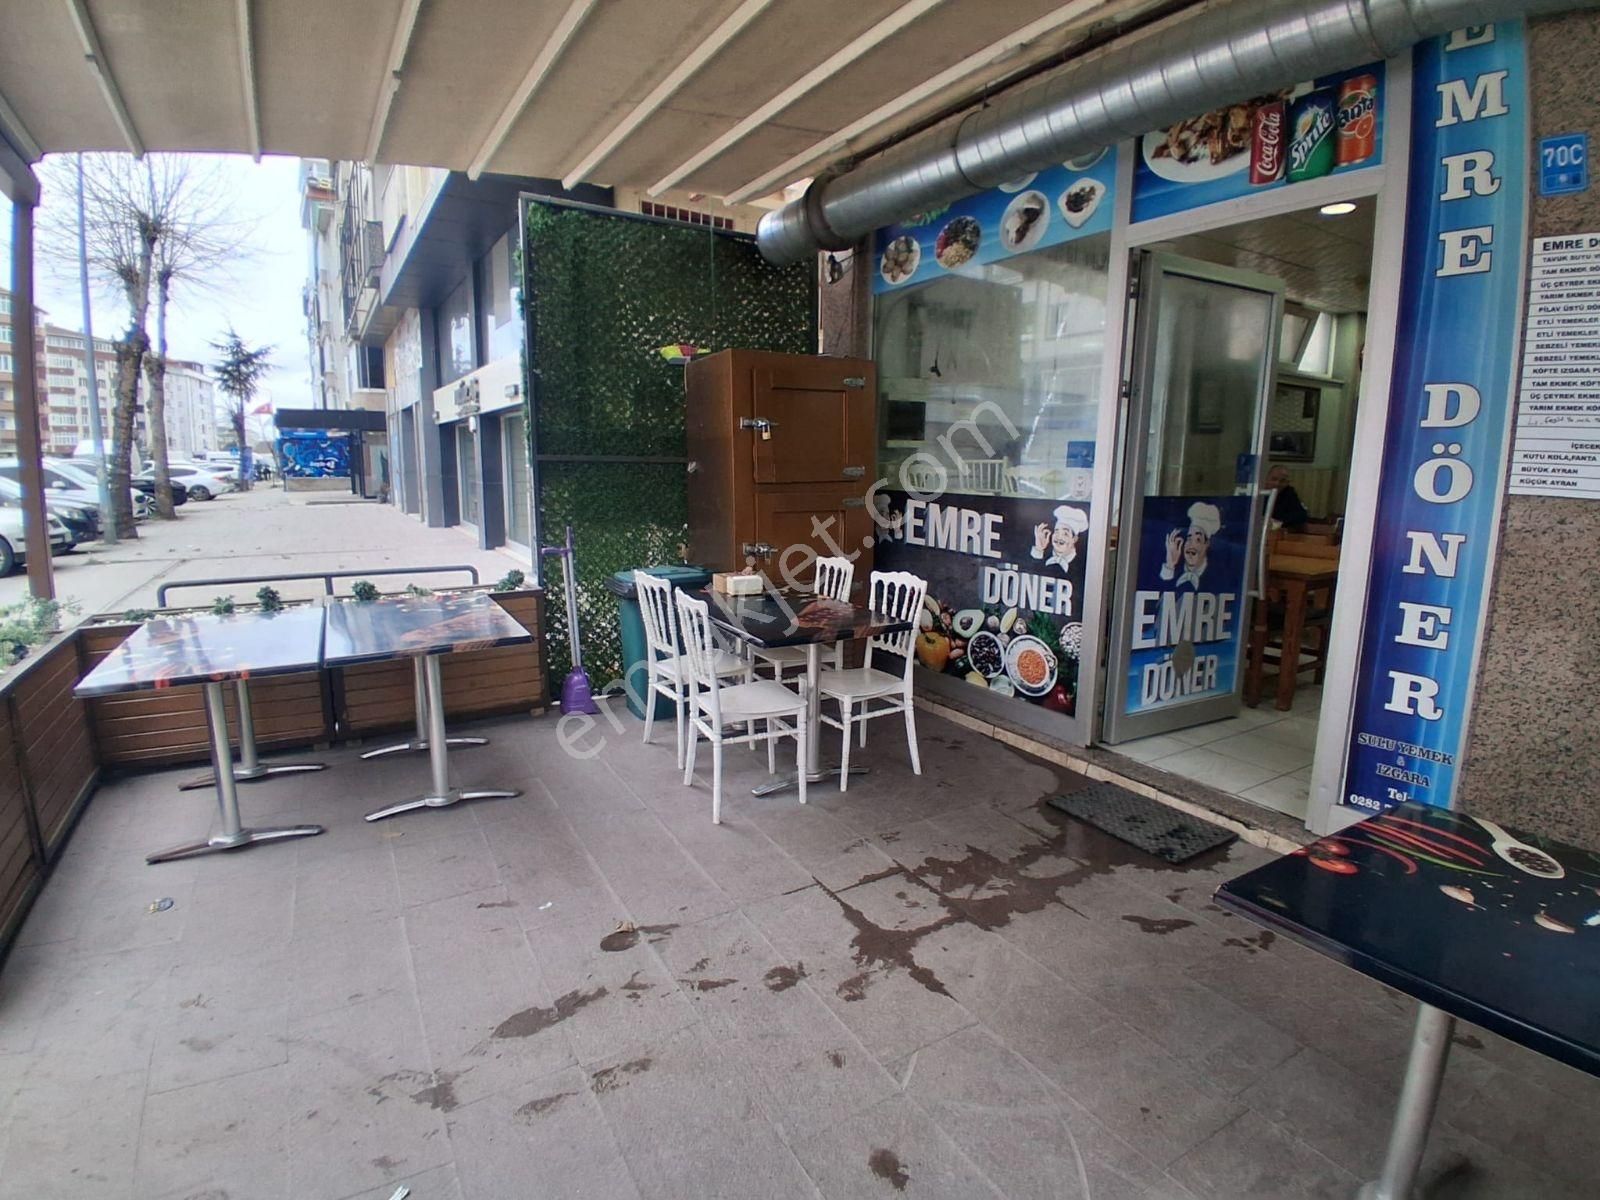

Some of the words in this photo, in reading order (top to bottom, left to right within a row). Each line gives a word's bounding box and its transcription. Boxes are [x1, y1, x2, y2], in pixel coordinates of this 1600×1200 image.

[1290, 111, 1331, 169] Sprite
[1544, 144, 1583, 168] 70C
[1542, 239, 1584, 251] EMRE
[1589, 237, 1600, 248] D
[1542, 255, 1568, 263] TAVUK
[1540, 281, 1551, 290] ÜÇ
[1553, 279, 1584, 289] ÇEYREK
[1538, 305, 1561, 313] PİLAV
[1563, 303, 1584, 311] ÜSTÜ
[1534, 354, 1566, 362] SEBZELİ
[1532, 366, 1559, 374] KÖFTE
[1530, 392, 1541, 401] ÜÇ
[1544, 393, 1576, 401] ÇEYREK
[1547, 454, 1598, 462] KOLA,FANTA
[1519, 478, 1549, 486] KÜÇÜK
[905, 498, 1004, 559] EMRE
[1383, 382, 1483, 723] DÖNER
[982, 562, 1074, 617] DÖNER
[1131, 590, 1236, 650] EMRE
[1358, 732, 1397, 751] SULU
[1397, 741, 1454, 766] YEMEK
[1396, 755, 1405, 767] &
[1376, 763, 1431, 789] IZGARA
[1349, 794, 1381, 811] 0282
